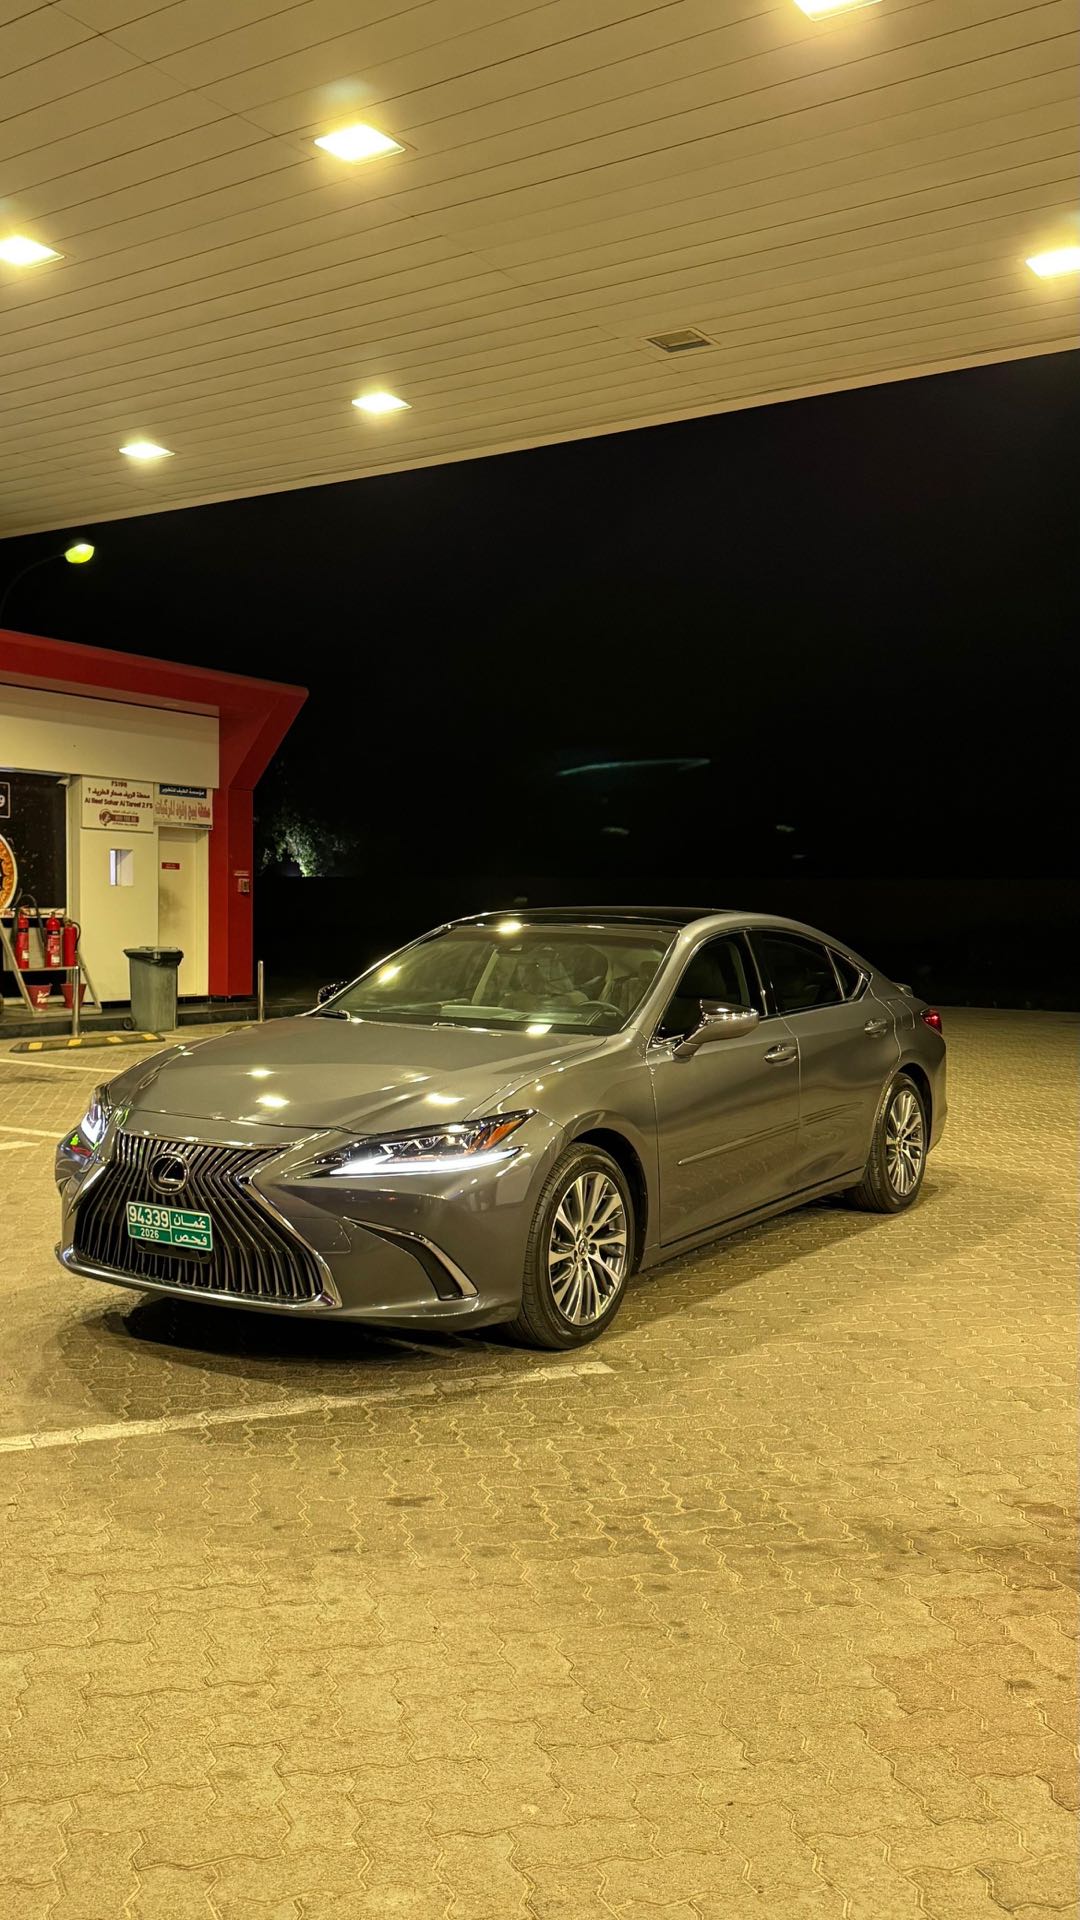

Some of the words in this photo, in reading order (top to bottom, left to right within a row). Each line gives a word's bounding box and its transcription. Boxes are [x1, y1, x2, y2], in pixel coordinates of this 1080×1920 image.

[128, 1205, 169, 1228] 94339
[140, 1227, 160, 1239] 2026
[174, 1233, 208, 1246] فحص
